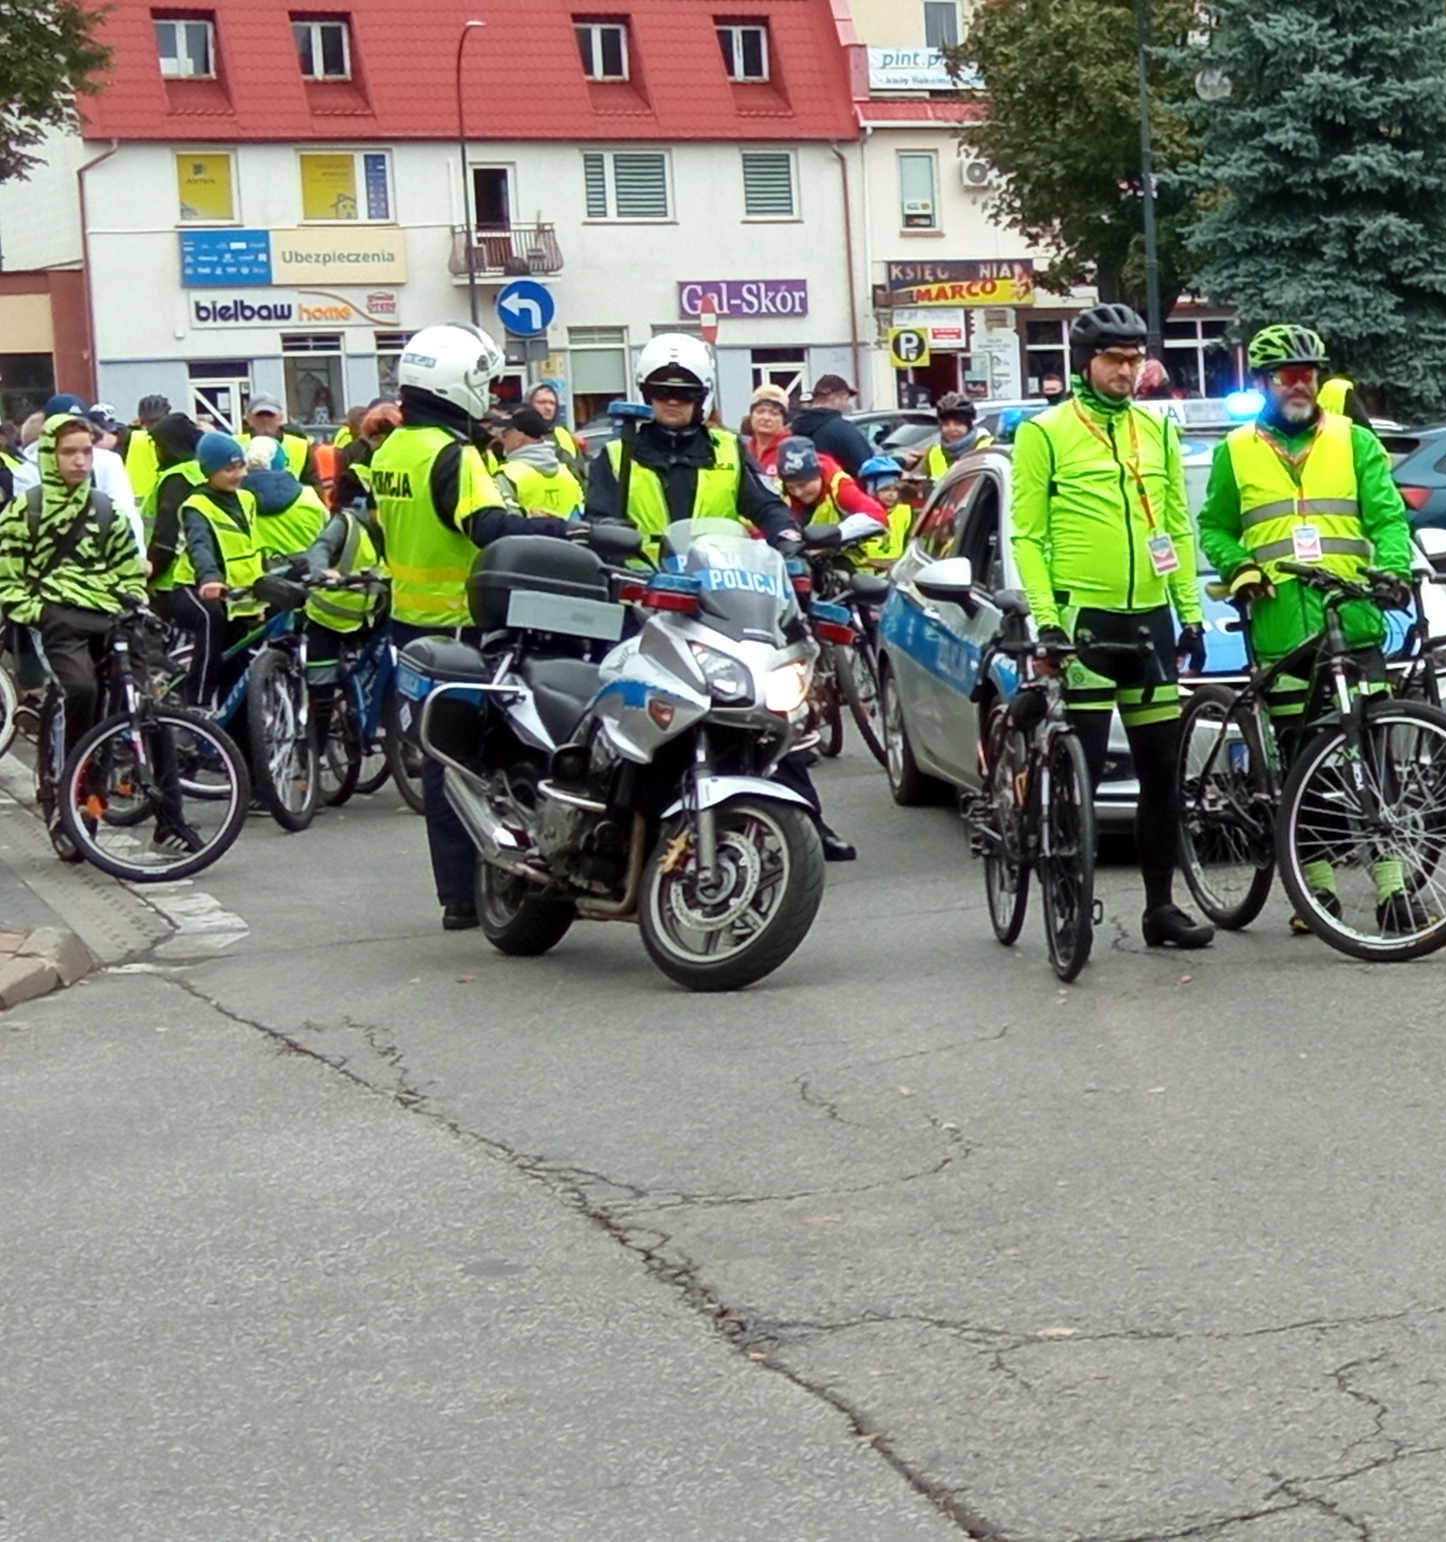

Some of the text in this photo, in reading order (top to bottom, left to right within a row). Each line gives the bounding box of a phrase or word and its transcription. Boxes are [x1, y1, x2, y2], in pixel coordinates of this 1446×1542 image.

[281, 250, 395, 267] Ubezpieczenia
[914, 280, 998, 302] MARCO
[194, 300, 292, 322] bielbaw
[298, 303, 352, 321] home
